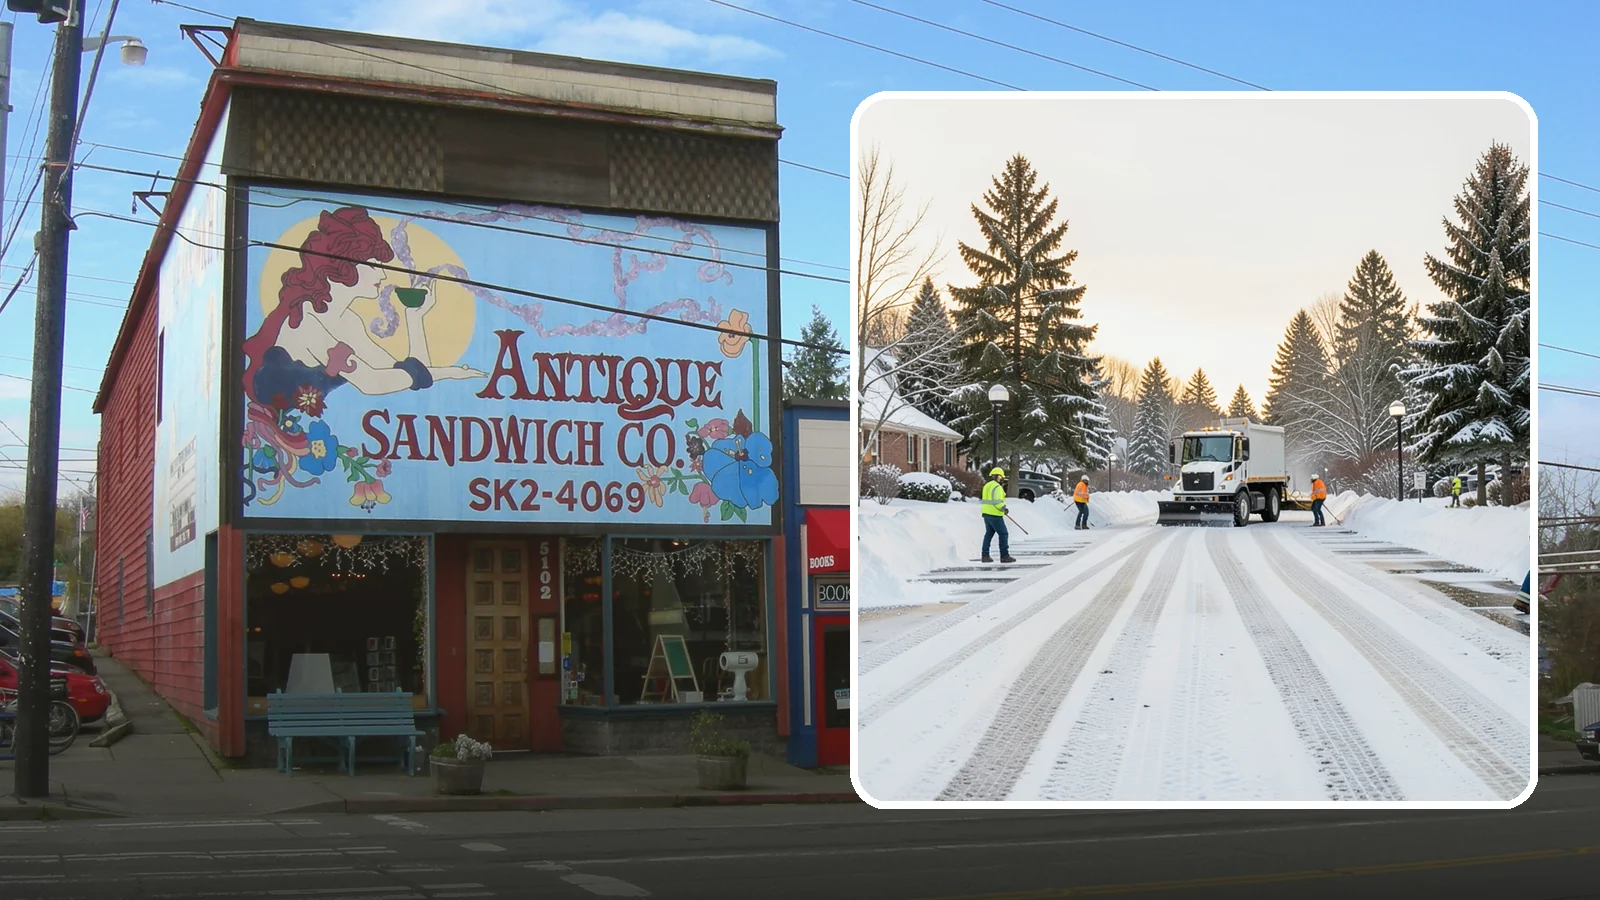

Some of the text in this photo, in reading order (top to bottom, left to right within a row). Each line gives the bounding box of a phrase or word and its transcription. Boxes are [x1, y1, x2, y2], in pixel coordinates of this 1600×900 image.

[475, 329, 723, 420] ANTIQUE
[361, 408, 684, 469] SANDWICH CO.
[468, 477, 646, 512] SK2-4069
[539, 541, 552, 600] 5102
[809, 555, 835, 569] BOOKS
